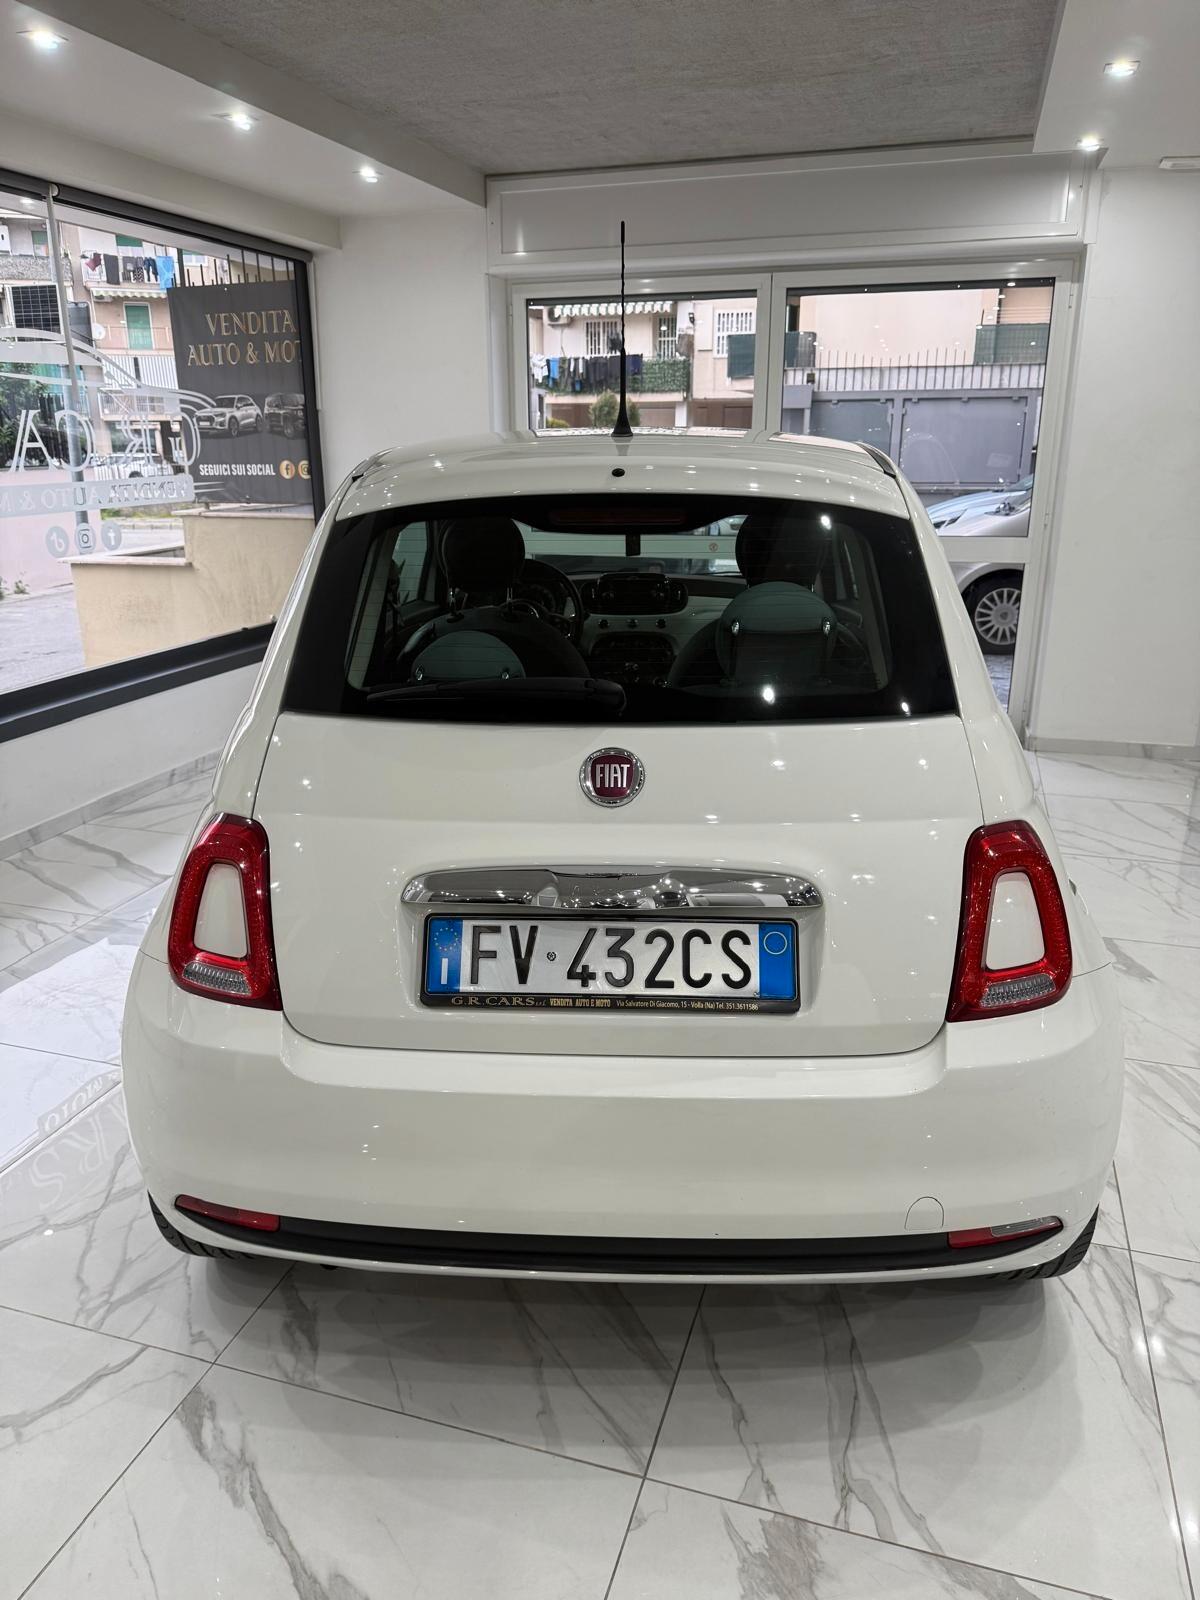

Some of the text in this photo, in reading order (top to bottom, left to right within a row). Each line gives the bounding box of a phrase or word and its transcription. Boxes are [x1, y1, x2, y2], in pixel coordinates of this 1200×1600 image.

[205, 309, 297, 336] VENDITA
[187, 342, 240, 367] AUTO
[246, 341, 260, 364] &
[199, 463, 231, 476] SEGUICI
[231, 463, 246, 476] SUI
[246, 463, 276, 476] SOCIAL
[595, 763, 630, 788] FIAT
[470, 924, 539, 985] FV
[566, 927, 752, 990] 432CS
[550, 998, 573, 1007] VENDITA
[575, 998, 590, 1007] AUTO
[595, 999, 611, 1008] MOTO
[616, 999, 625, 1008] Via
[625, 1000, 649, 1008] Salvatore
[650, 1000, 656, 1008] Di
[656, 1001, 680, 1010] Giacomo,
[681, 1001, 688, 1009] 15
[691, 1001, 704, 1009] Volla
[704, 1001, 715, 1010] (Na)
[716, 1001, 725, 1010] Tel.
